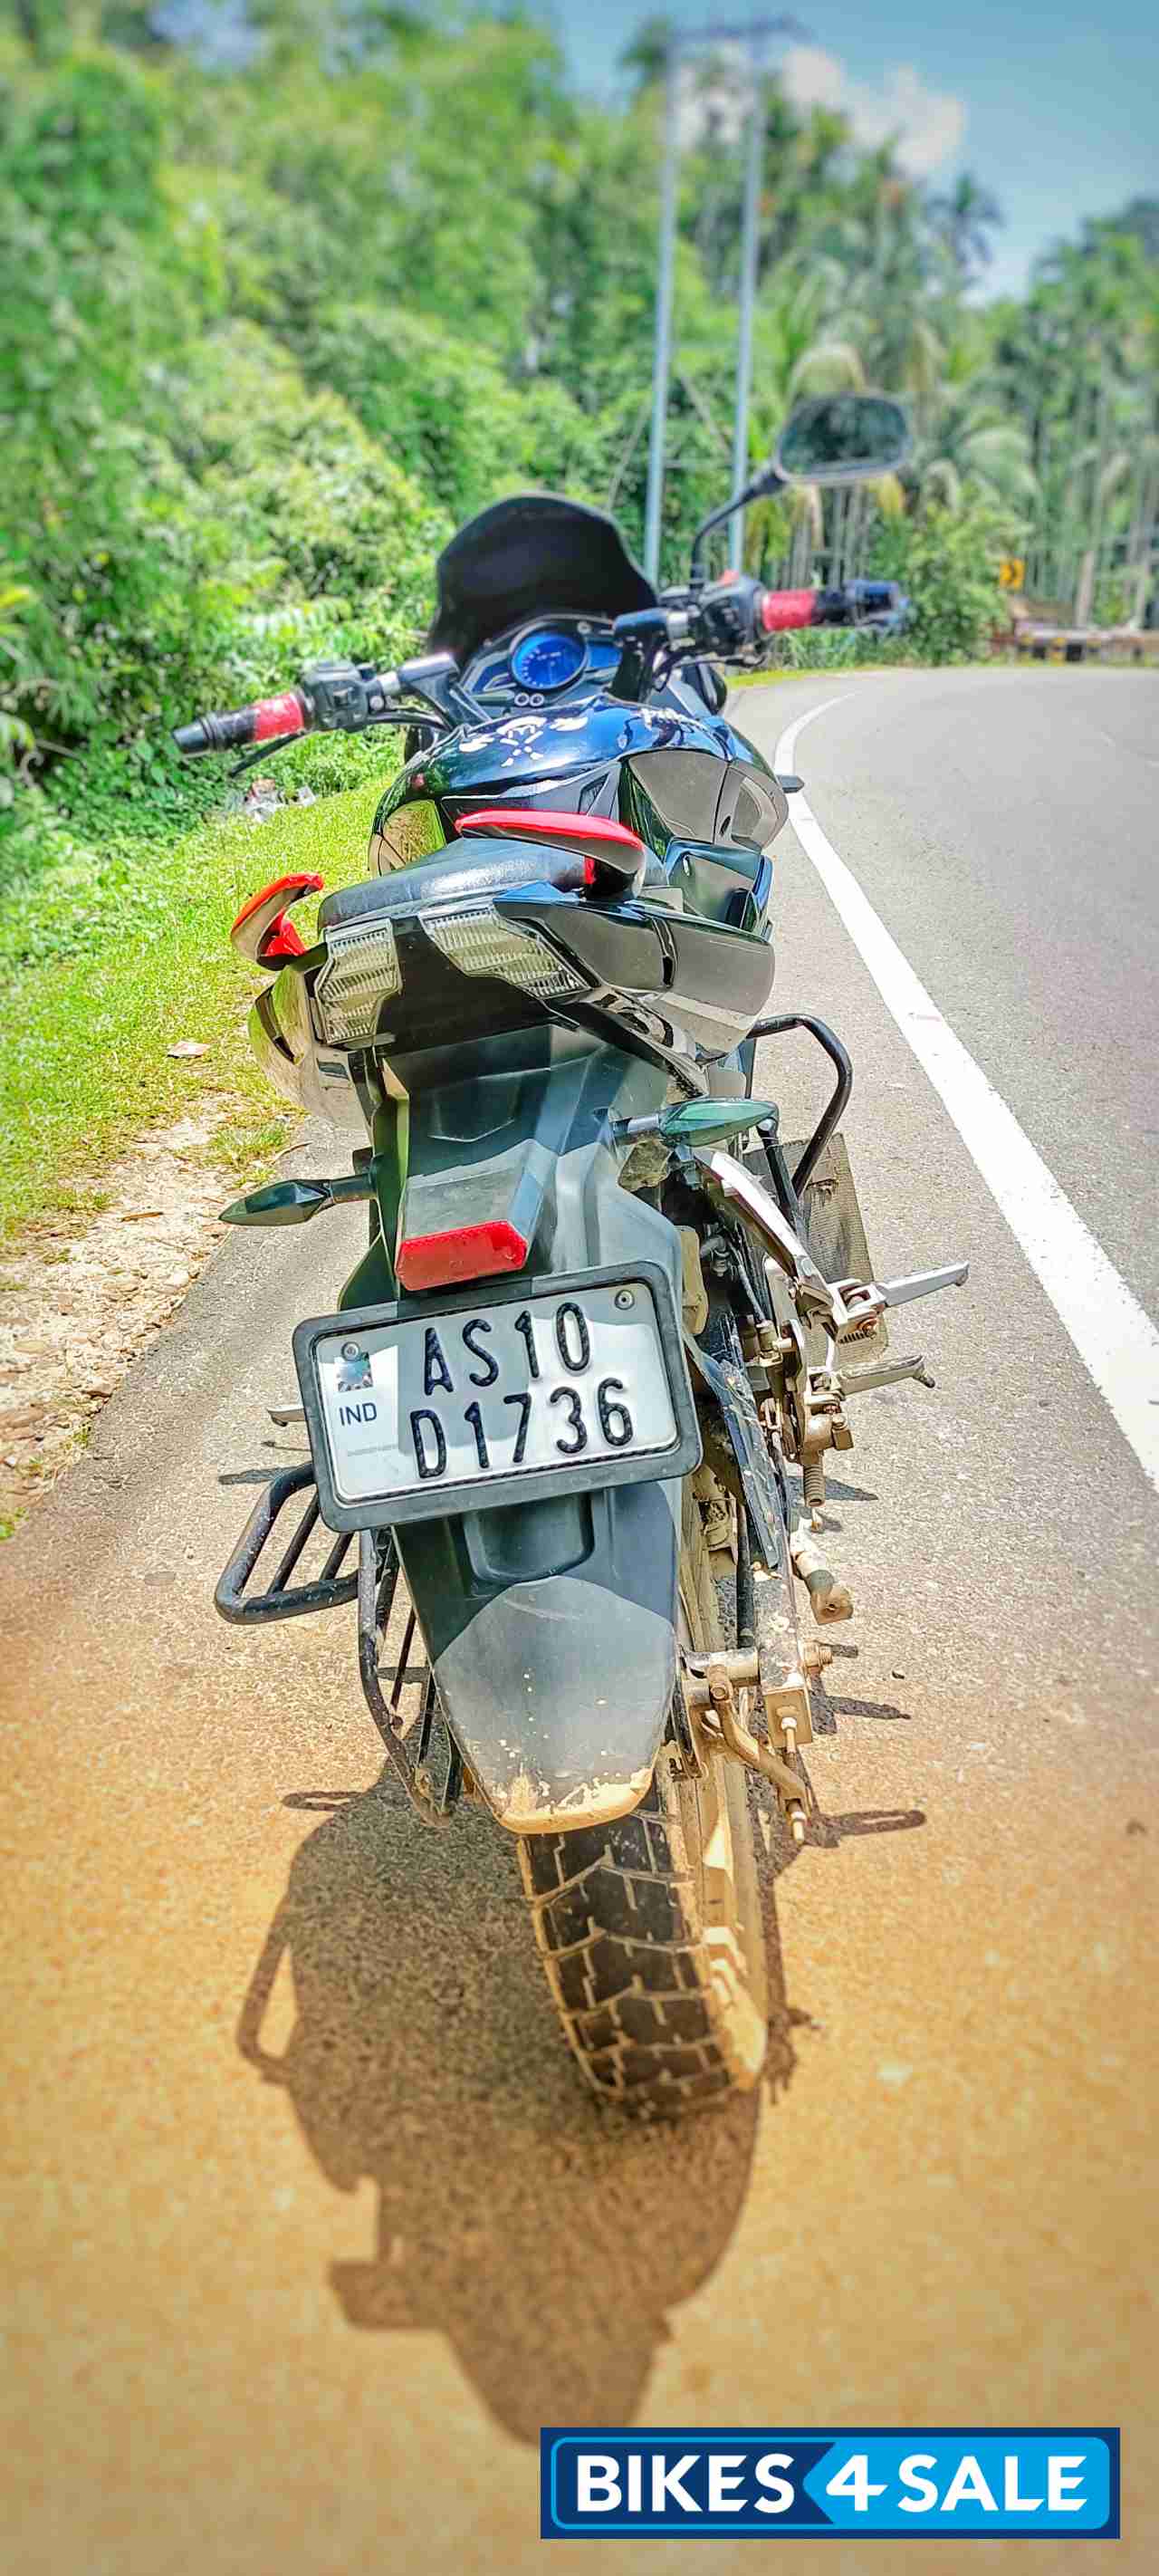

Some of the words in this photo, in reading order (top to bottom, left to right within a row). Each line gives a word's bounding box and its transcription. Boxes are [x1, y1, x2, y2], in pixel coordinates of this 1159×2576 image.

[424, 1302, 590, 1397] AS10
[339, 1401, 378, 1427] IND
[409, 1378, 634, 1479] D1736
